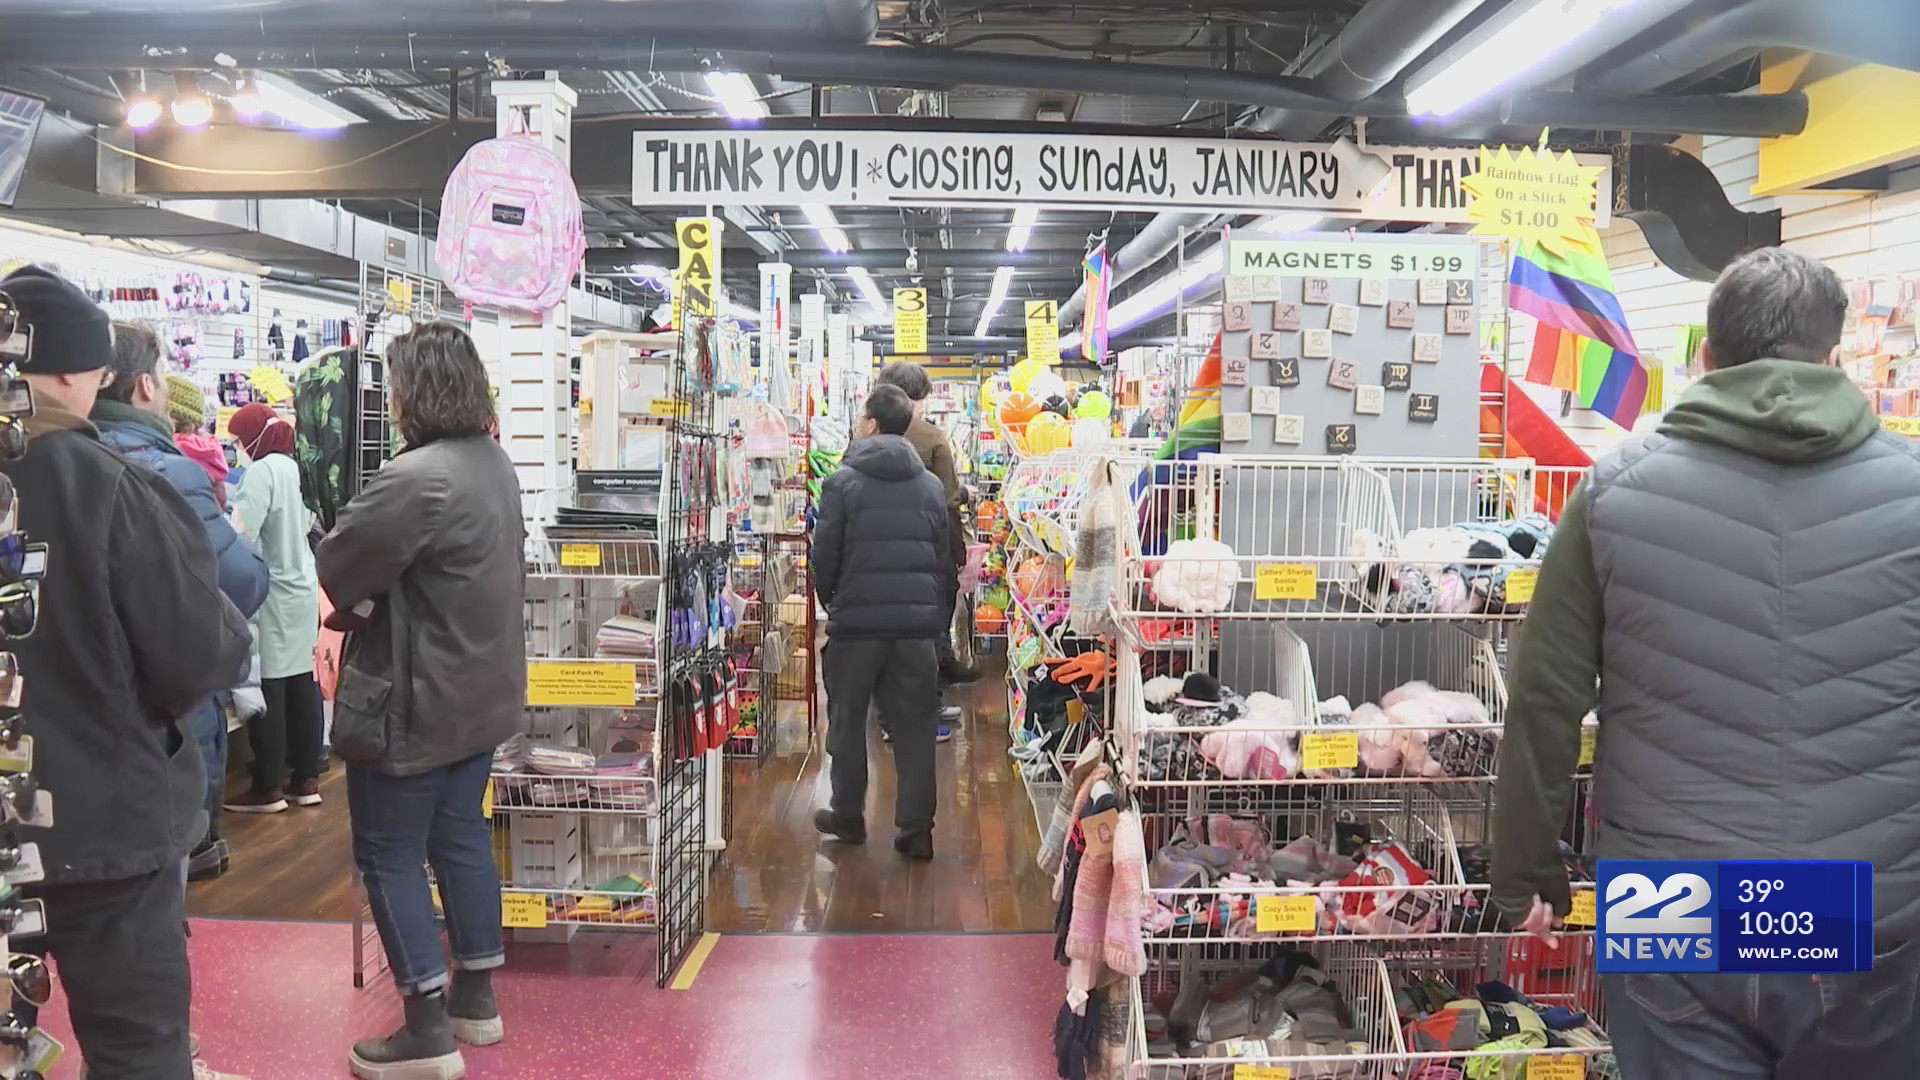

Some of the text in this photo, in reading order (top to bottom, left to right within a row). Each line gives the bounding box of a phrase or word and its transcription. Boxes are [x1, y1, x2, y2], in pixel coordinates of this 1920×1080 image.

[645, 138, 764, 193] THANK
[773, 138, 858, 201] YOU!
[1193, 147, 1339, 200] JANUARY
[1486, 166, 1580, 187] Rainbow Flag
[1393, 154, 1481, 209] THAN
[1495, 187, 1567, 205] On a Stick
[1500, 208, 1559, 228] $1.00
[1244, 251, 1463, 273] MAGNETS $1.99
[896, 289, 925, 312] 3
[1027, 301, 1057, 324] 4
[592, 478, 625, 487] computer
[1263, 904, 1308, 914] Cozy Socks
